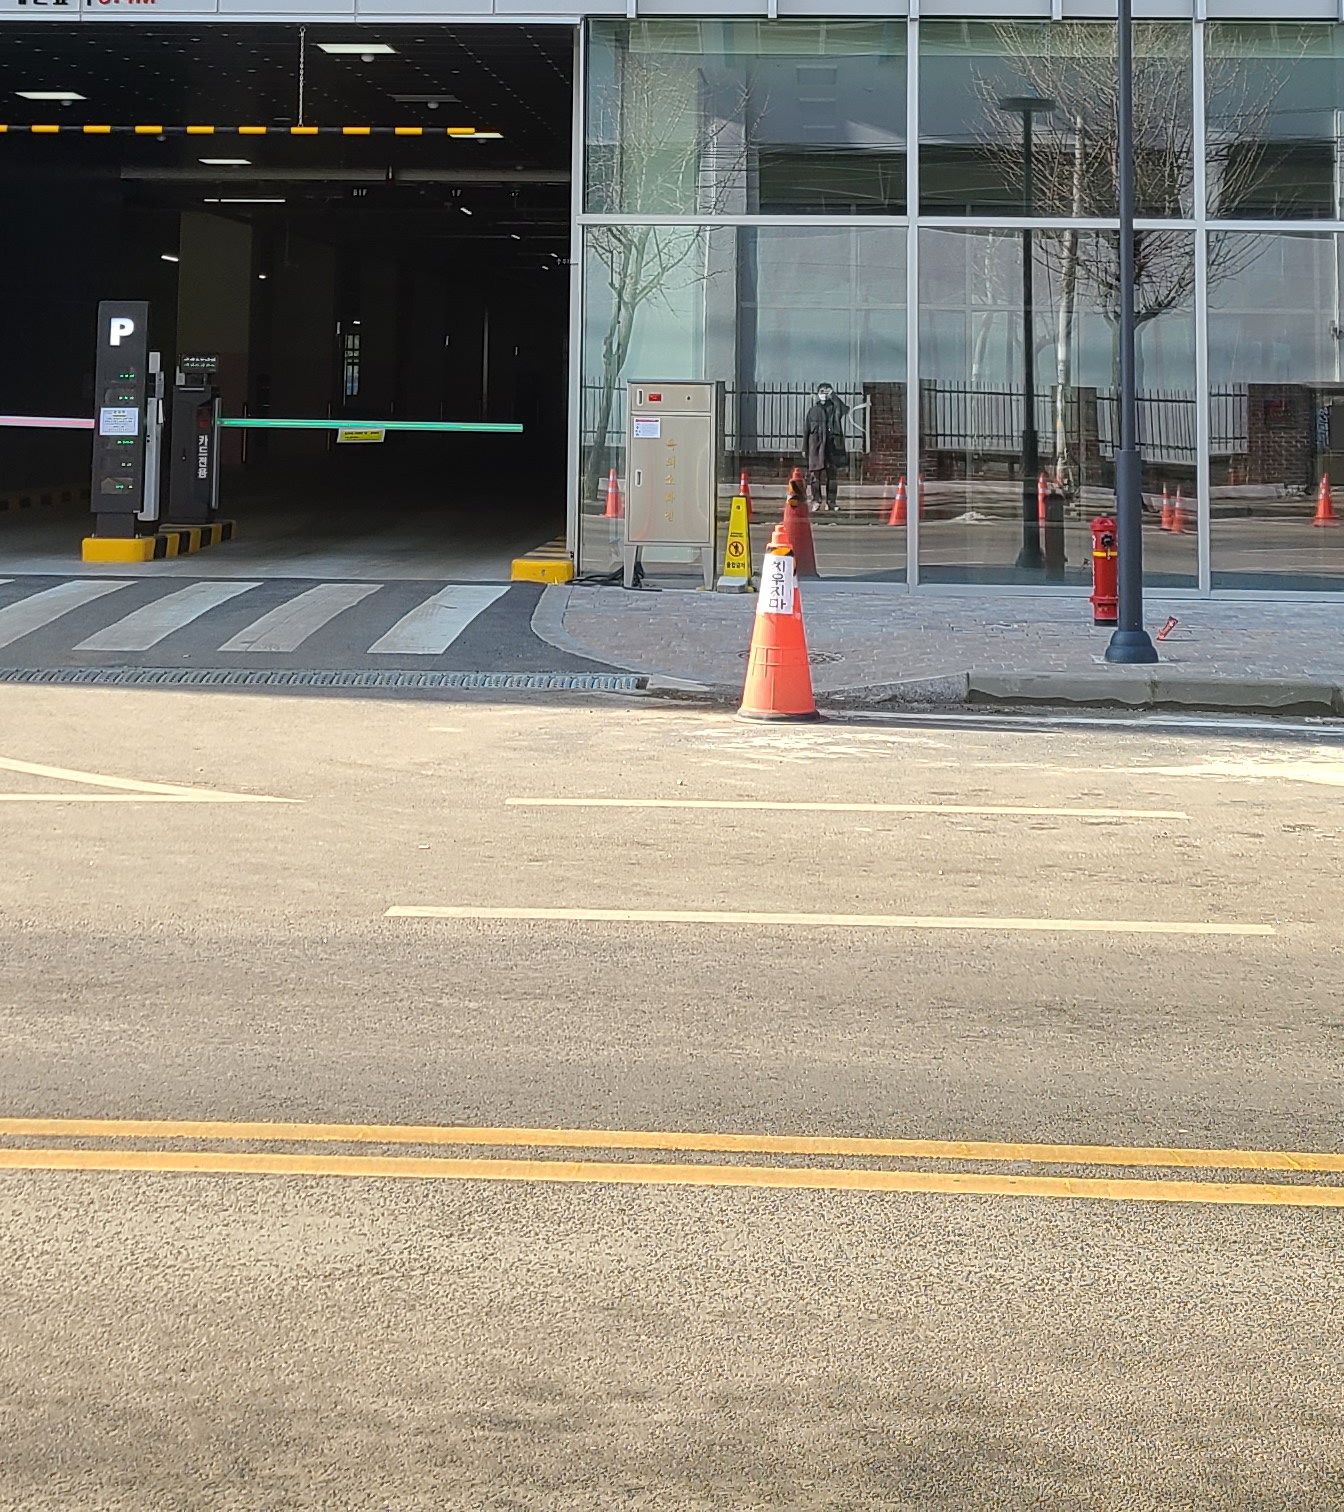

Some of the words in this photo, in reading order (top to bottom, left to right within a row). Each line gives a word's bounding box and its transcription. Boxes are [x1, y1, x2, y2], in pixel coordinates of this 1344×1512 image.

[110, 317, 134, 346] P
[198, 434, 209, 479] 카드전용
[769, 560, 787, 610] 치우지마
